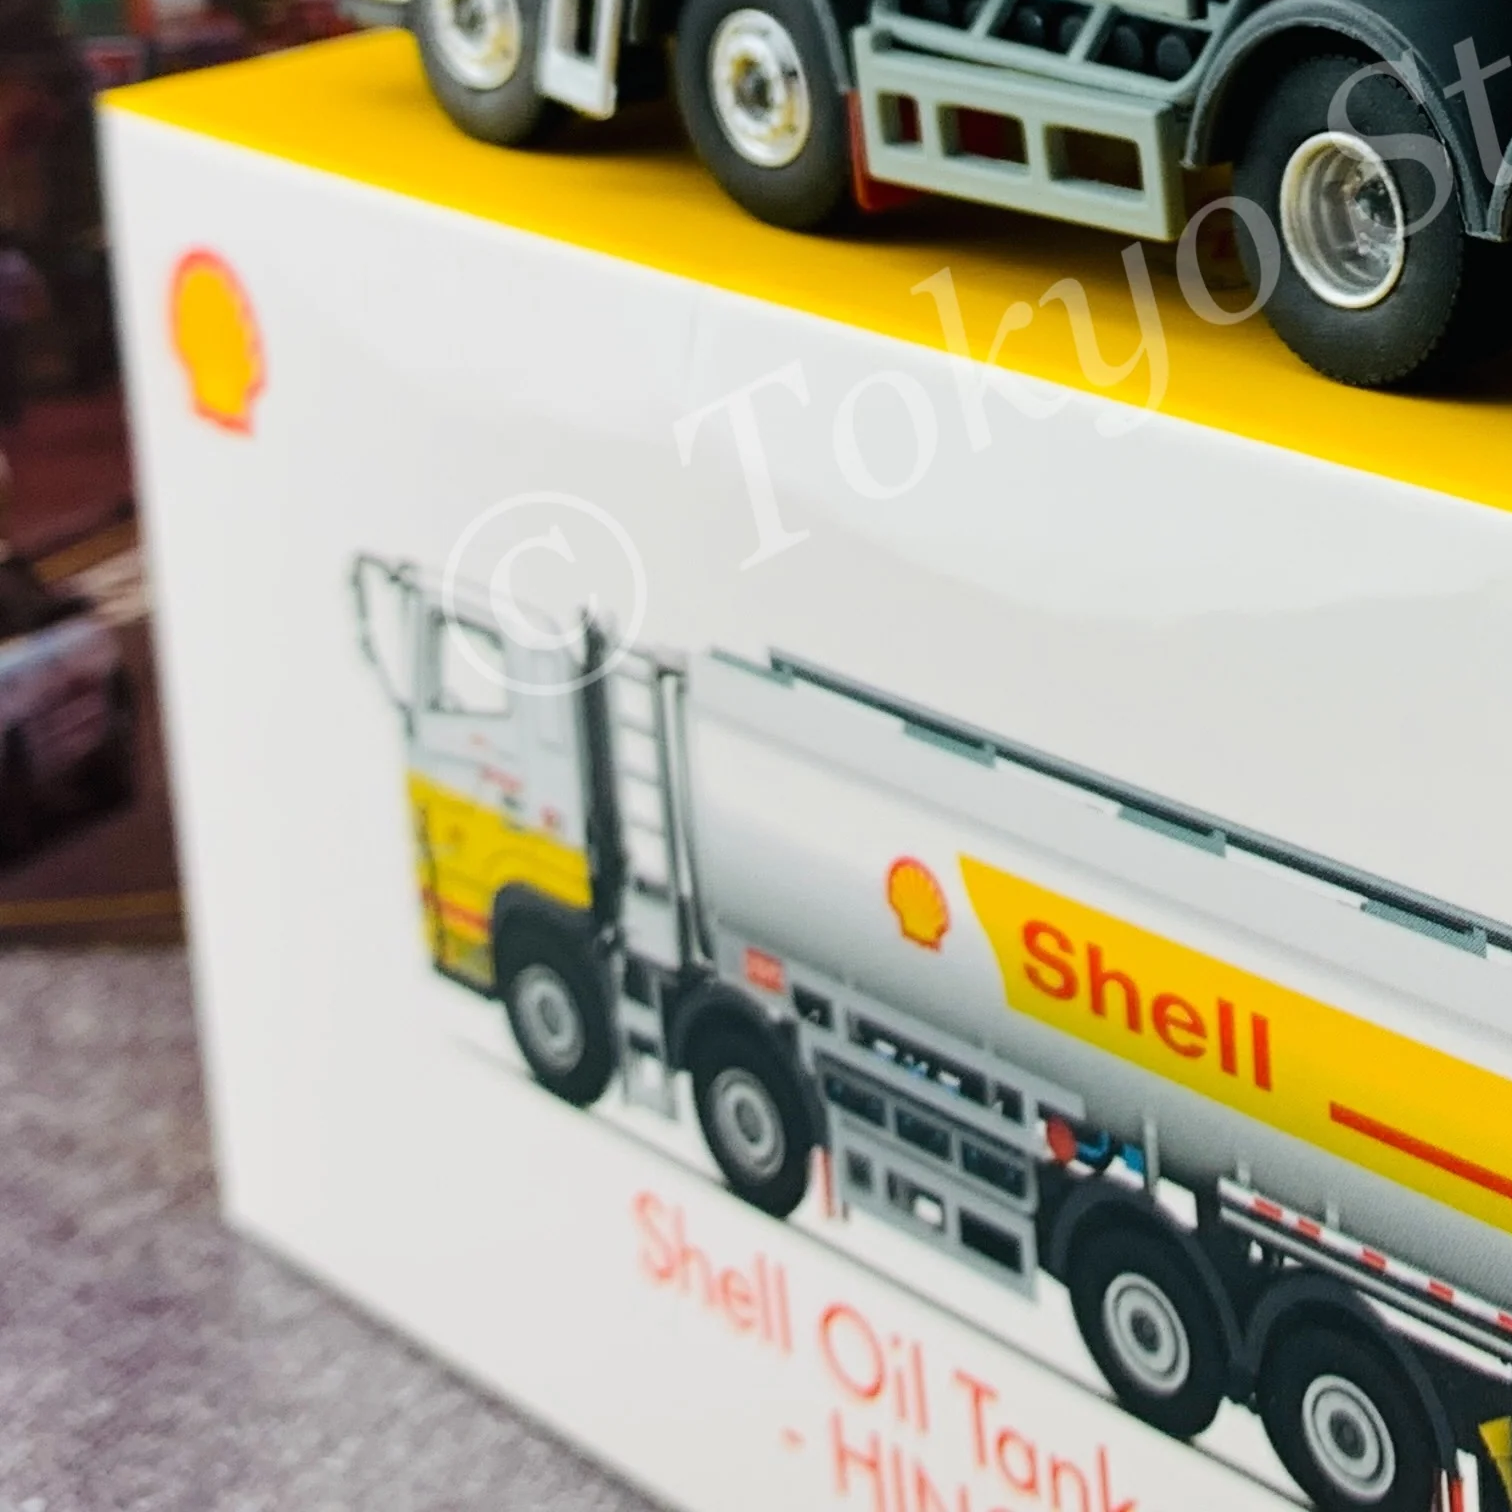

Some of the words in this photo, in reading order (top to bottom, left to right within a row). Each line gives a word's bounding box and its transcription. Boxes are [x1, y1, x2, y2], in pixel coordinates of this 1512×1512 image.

[1021, 919, 1273, 1092] Shell
[632, 1190, 794, 1355] Shell
[816, 1300, 931, 1437] Oil
[830, 1408, 1012, 1512] HIN
